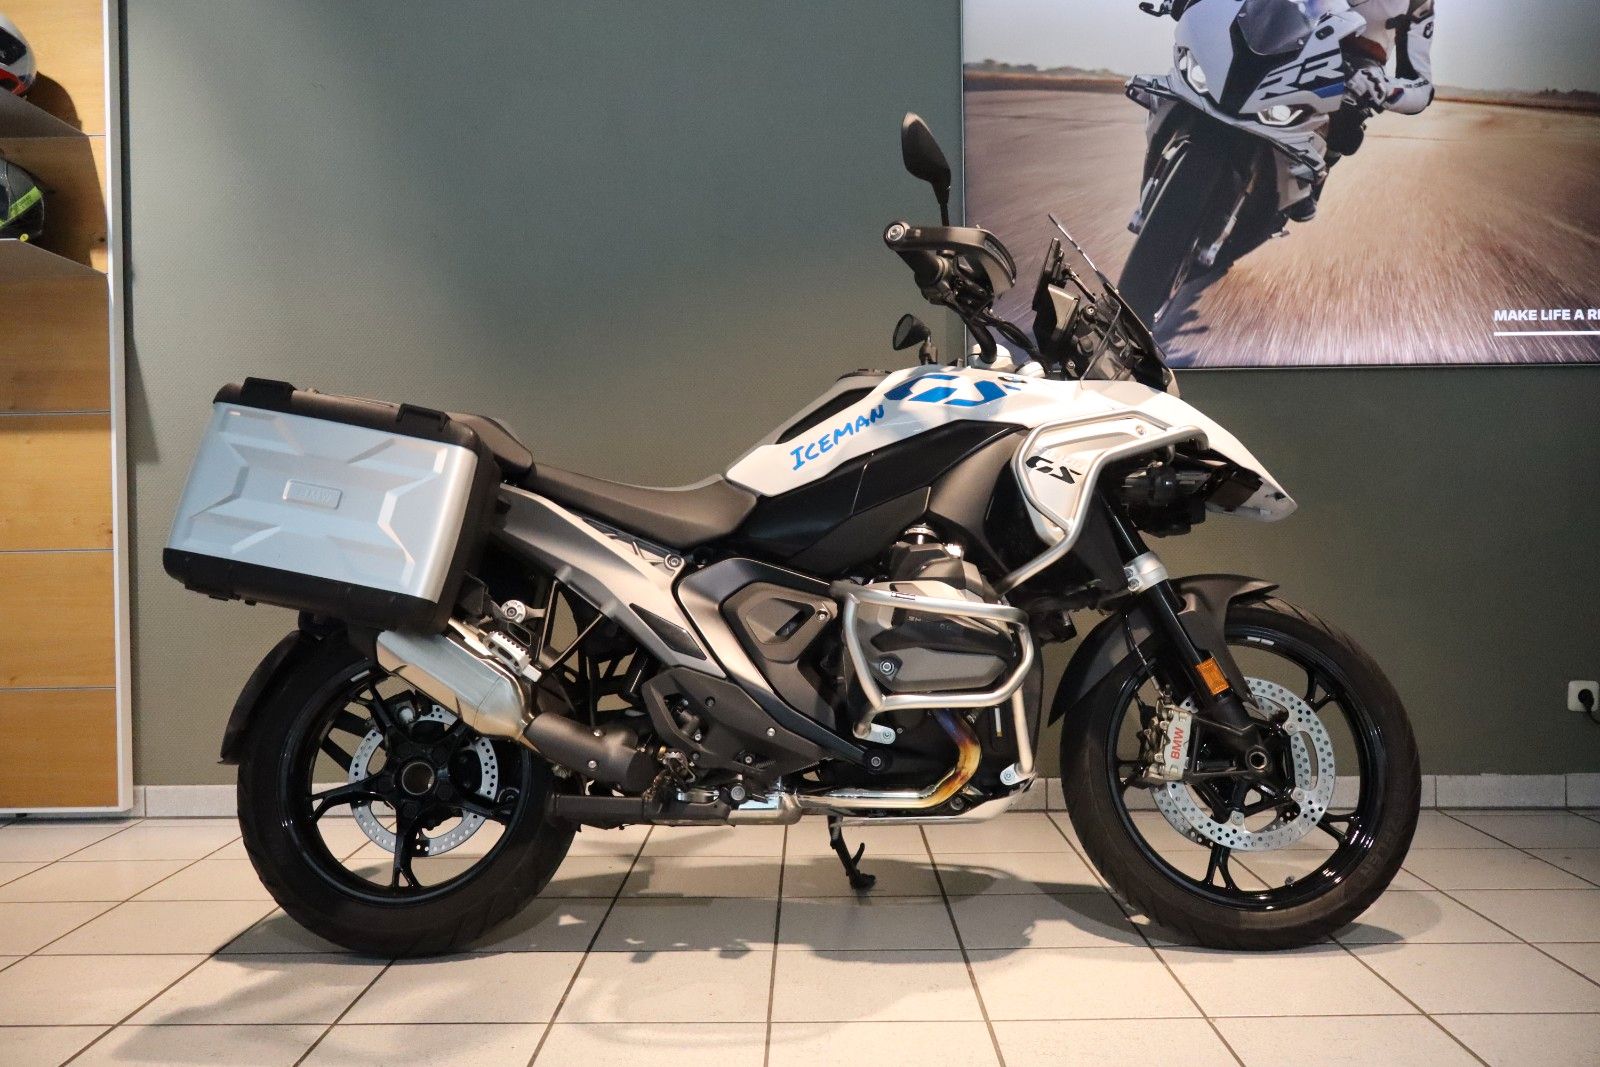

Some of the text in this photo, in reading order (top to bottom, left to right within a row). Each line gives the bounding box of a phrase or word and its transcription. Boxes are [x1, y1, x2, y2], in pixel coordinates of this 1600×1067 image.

[1494, 309, 1537, 321] MAKE
[1541, 309, 1570, 320] LIFE
[1574, 309, 1584, 320] A
[790, 405, 884, 471] ICEMAN
[1025, 456, 1082, 484] GS
[1171, 727, 1184, 759] BMW
